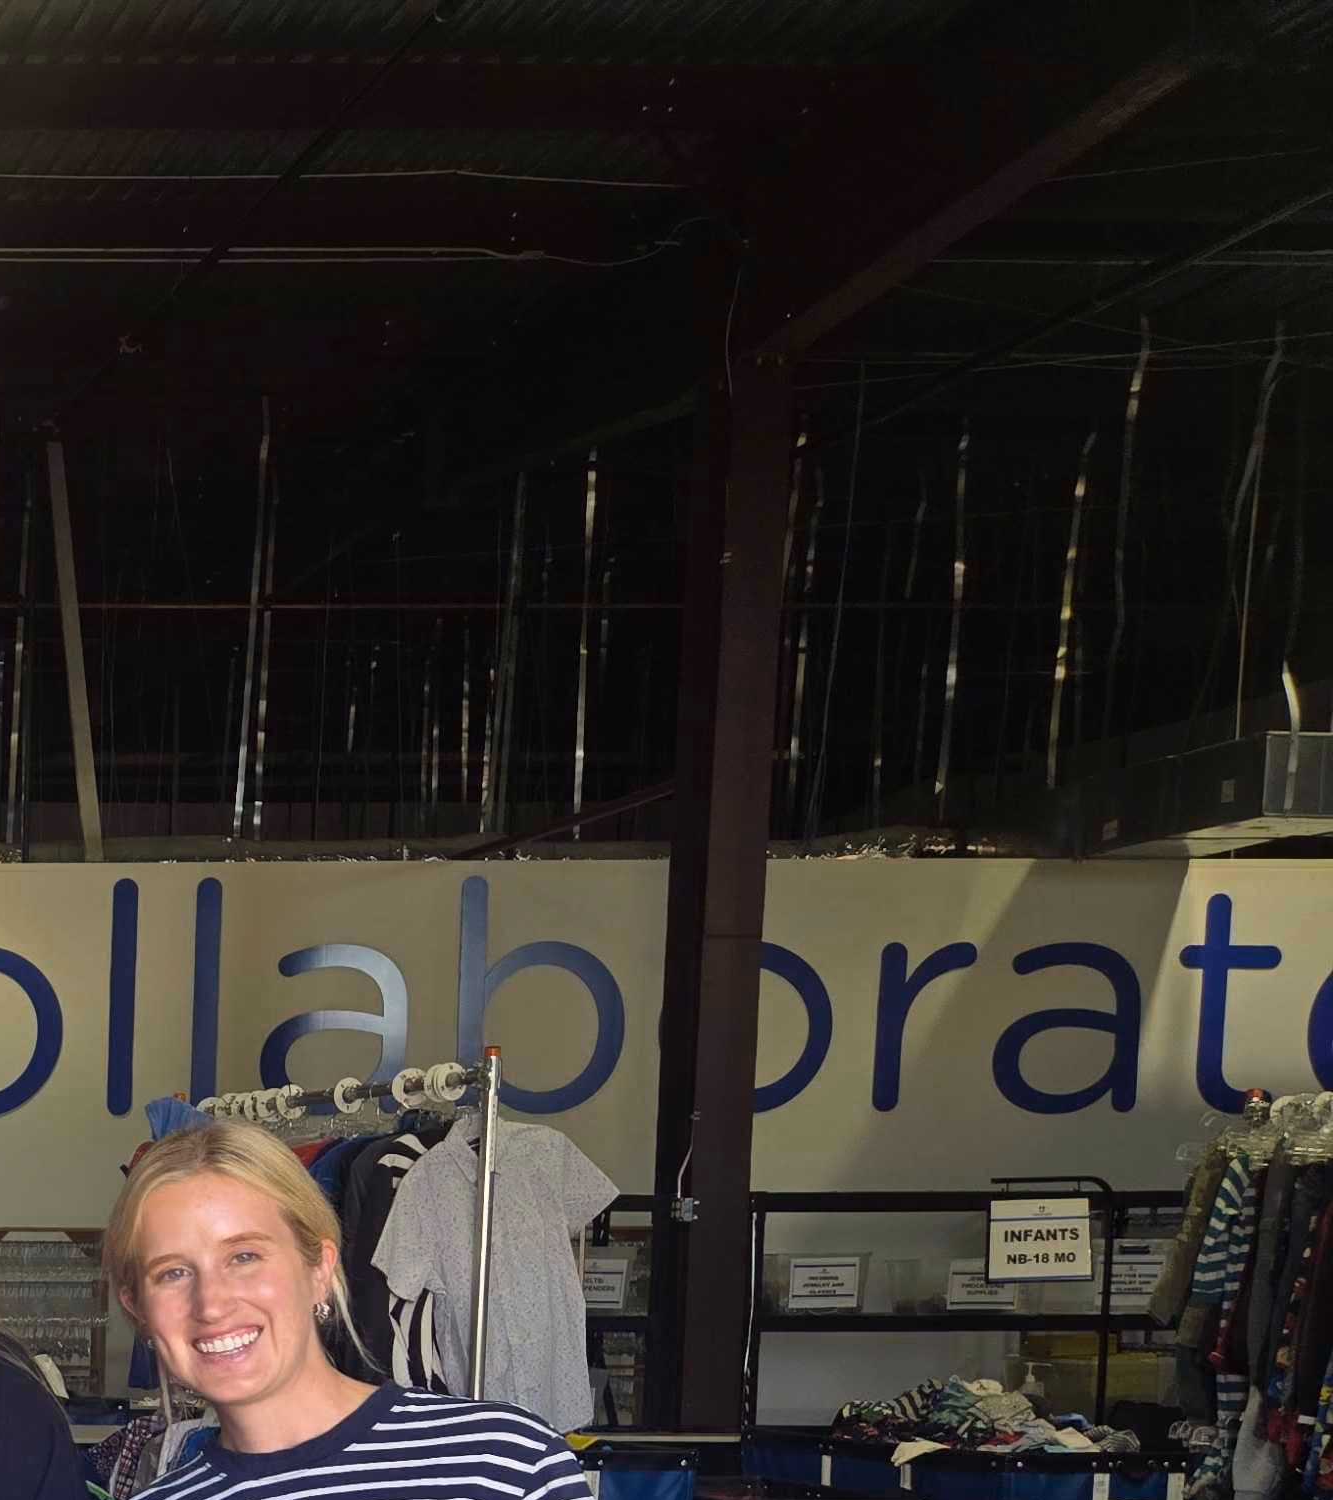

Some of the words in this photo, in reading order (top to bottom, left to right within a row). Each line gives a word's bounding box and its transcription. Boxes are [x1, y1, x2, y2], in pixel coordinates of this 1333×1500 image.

[1004, 1228, 1080, 1242] INFANTS
[1006, 1253, 1050, 1265] NB-18
[1054, 1252, 1076, 1263] MO
